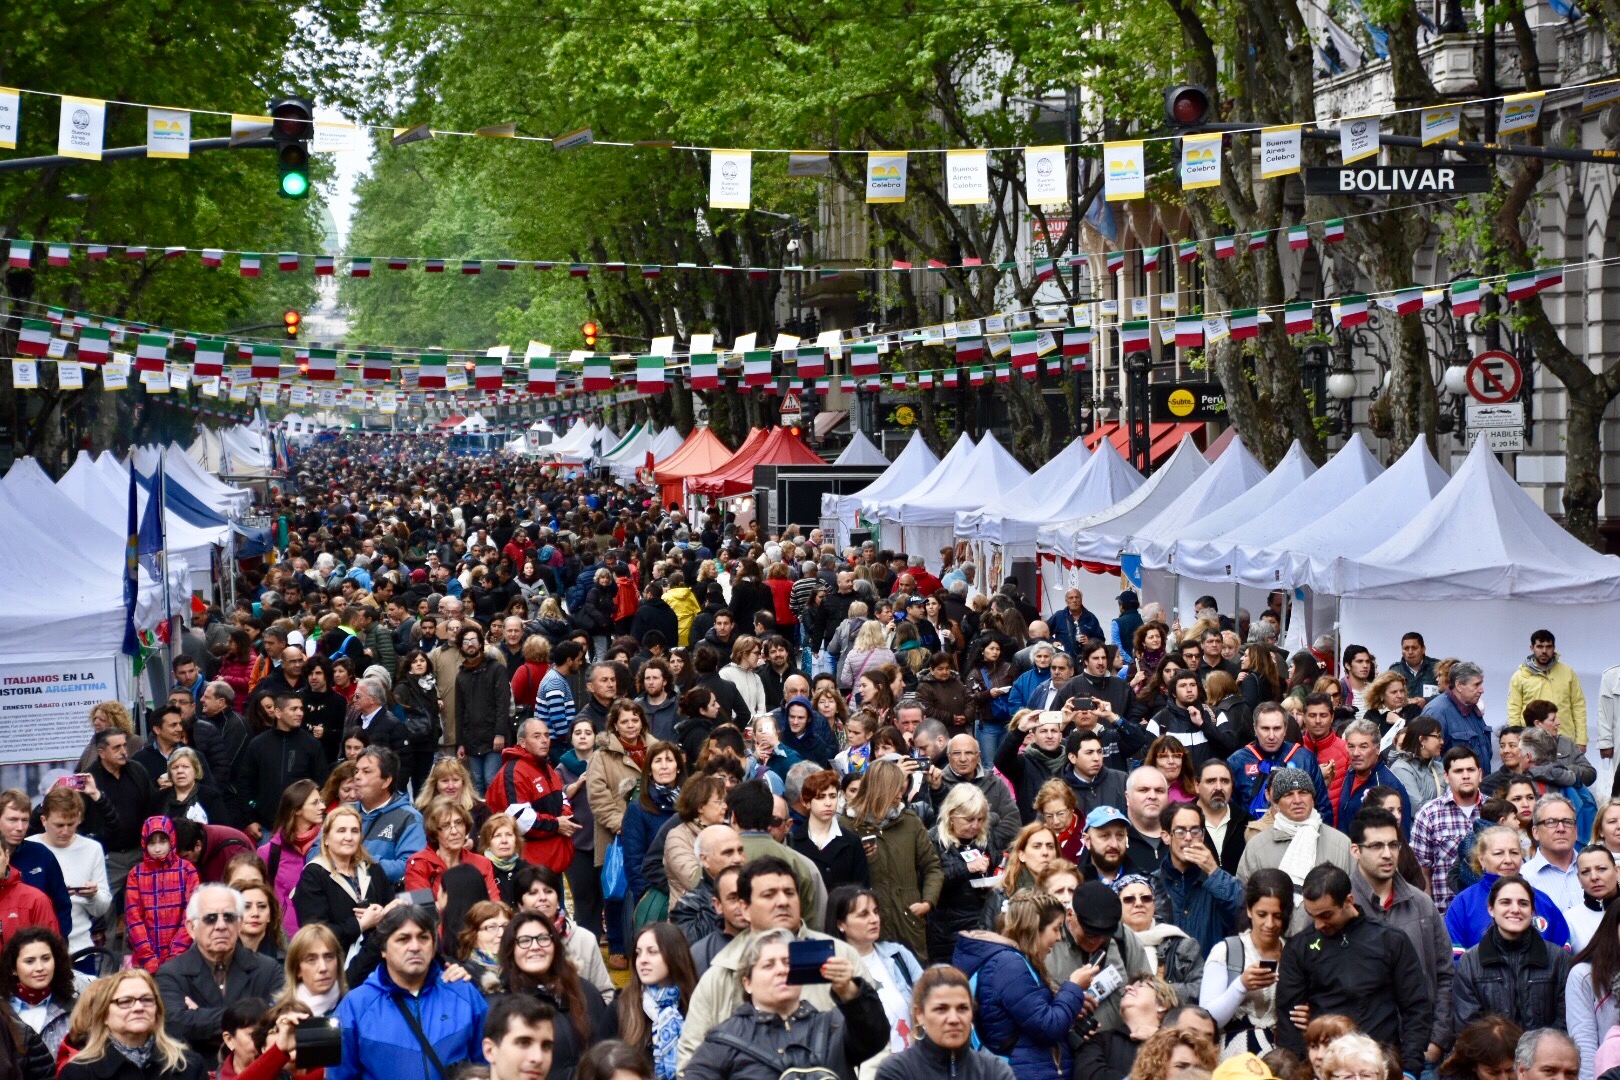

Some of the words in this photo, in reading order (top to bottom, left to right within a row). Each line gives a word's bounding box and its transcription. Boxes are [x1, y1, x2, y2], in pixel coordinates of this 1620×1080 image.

[1504, 113, 1534, 124] Celebra
[1266, 154, 1295, 162] Celebra
[1340, 168, 1455, 191] BOLIVAR
[1482, 362, 1504, 393] E
[1201, 394, 1223, 404] Perú
[3, 675, 59, 685] ITALIANOS
[45, 683, 107, 693] ARGENTINA
